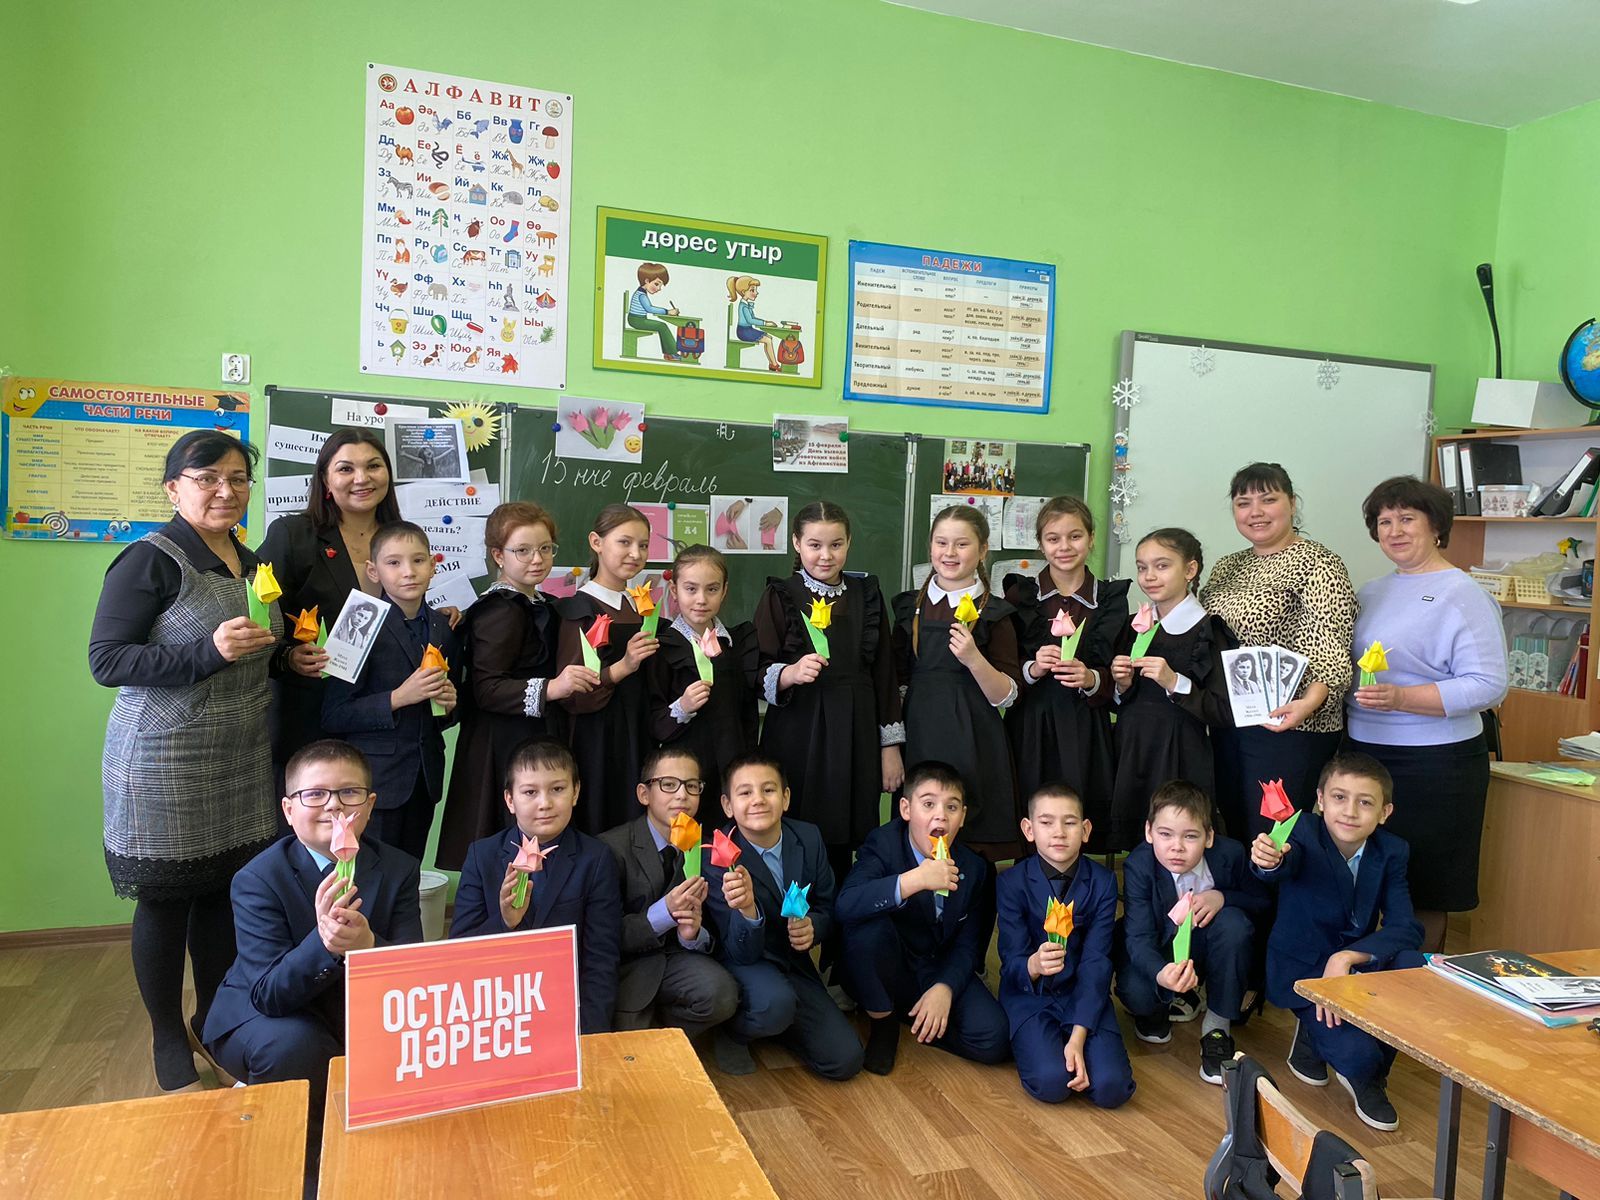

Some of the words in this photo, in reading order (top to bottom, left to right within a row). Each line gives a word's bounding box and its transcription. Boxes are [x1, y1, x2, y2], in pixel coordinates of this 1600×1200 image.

[404, 79, 541, 112] АЛФАВИТ
[379, 99, 395, 110] Аа
[418, 105, 433, 115] Әә
[457, 111, 472, 121] Бб
[493, 116, 508, 126] Вв
[530, 121, 540, 131] Гг
[378, 135, 395, 145] Дд
[417, 140, 431, 150] Ее
[492, 150, 509, 160] Жж
[378, 168, 391, 177] Зз
[417, 173, 432, 182] Ии
[455, 176, 470, 187] Йй
[491, 183, 504, 192] Кк
[527, 187, 542, 197] Лл
[377, 203, 396, 213] Мм
[416, 208, 430, 217] Нн
[490, 216, 505, 226] Оо
[527, 221, 541, 230] Өө
[377, 235, 392, 244] Пп
[415, 239, 429, 249] Рр
[453, 243, 467, 252] Сс
[489, 247, 502, 256] Тт
[525, 251, 539, 261] Уу
[642, 229, 718, 253] дөрес
[725, 240, 783, 264] утыр
[922, 256, 983, 272] ПАДЕЖИ
[414, 274, 434, 284] Фф
[452, 277, 466, 287] Хх
[525, 285, 540, 295] Цц
[857, 281, 897, 289] Именительный
[375, 303, 389, 312] Чч
[413, 307, 434, 316] Шш
[451, 310, 472, 321] Щщ
[525, 318, 544, 327] Ыы
[857, 301, 892, 310] Родительный
[856, 323, 885, 332] Дательный
[412, 342, 427, 350] Ээ
[450, 344, 471, 353] Юю
[487, 348, 500, 357] Яя
[854, 362, 891, 370] Творительный
[49, 386, 205, 407] САМОСТОЯТЕЛЬНЫЕ
[84, 404, 130, 418] ЧАСТИ
[135, 408, 173, 421] РЕЧИ
[347, 412, 361, 422] На
[364, 416, 384, 425] уро
[275, 441, 321, 454] существи
[312, 433, 326, 442] Им
[574, 467, 611, 487] нче
[624, 460, 718, 504] февраль
[424, 498, 482, 509] ДЕЙСТВИЕ
[383, 971, 546, 1033] ОСТАЛЫК
[396, 1013, 532, 1082] ДӘРЕСЕ
